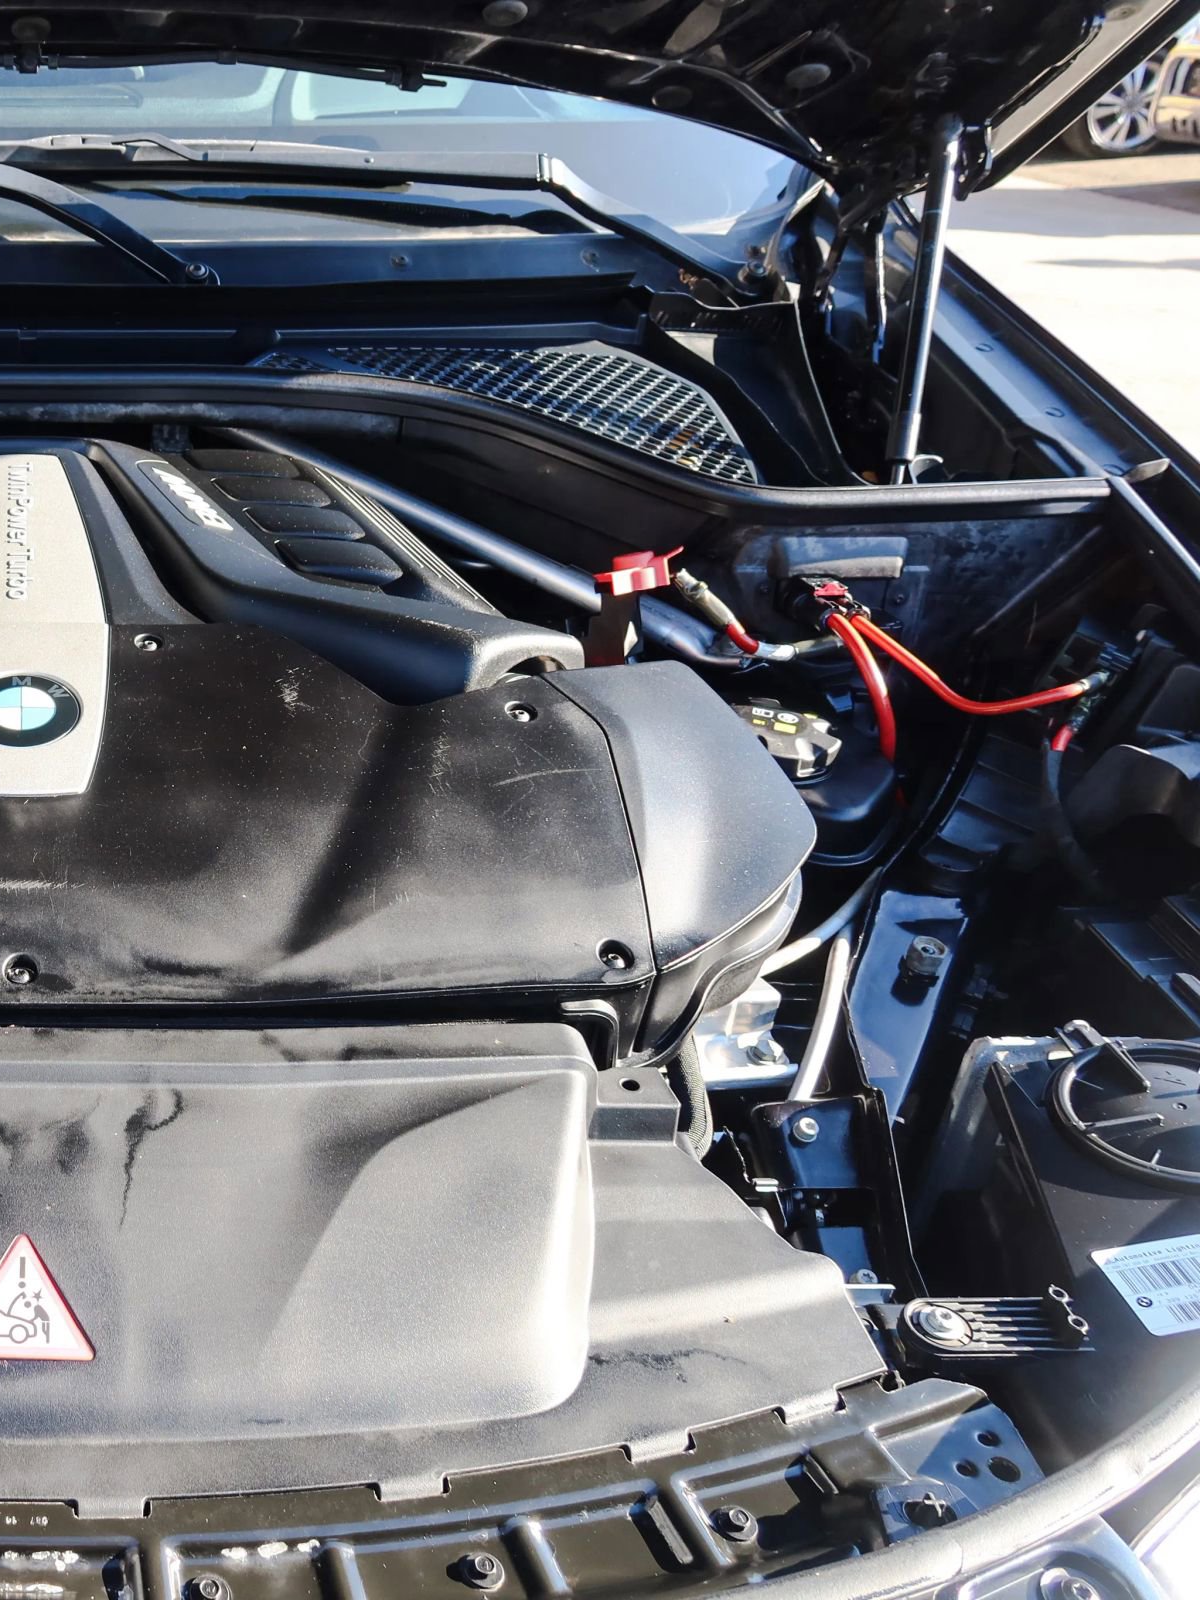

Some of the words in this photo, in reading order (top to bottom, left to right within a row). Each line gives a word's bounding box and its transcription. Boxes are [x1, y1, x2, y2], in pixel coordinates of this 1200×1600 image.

[6, 462, 33, 547] TwinPower
[151, 466, 234, 531] BMW
[5, 548, 34, 601] Turbo
